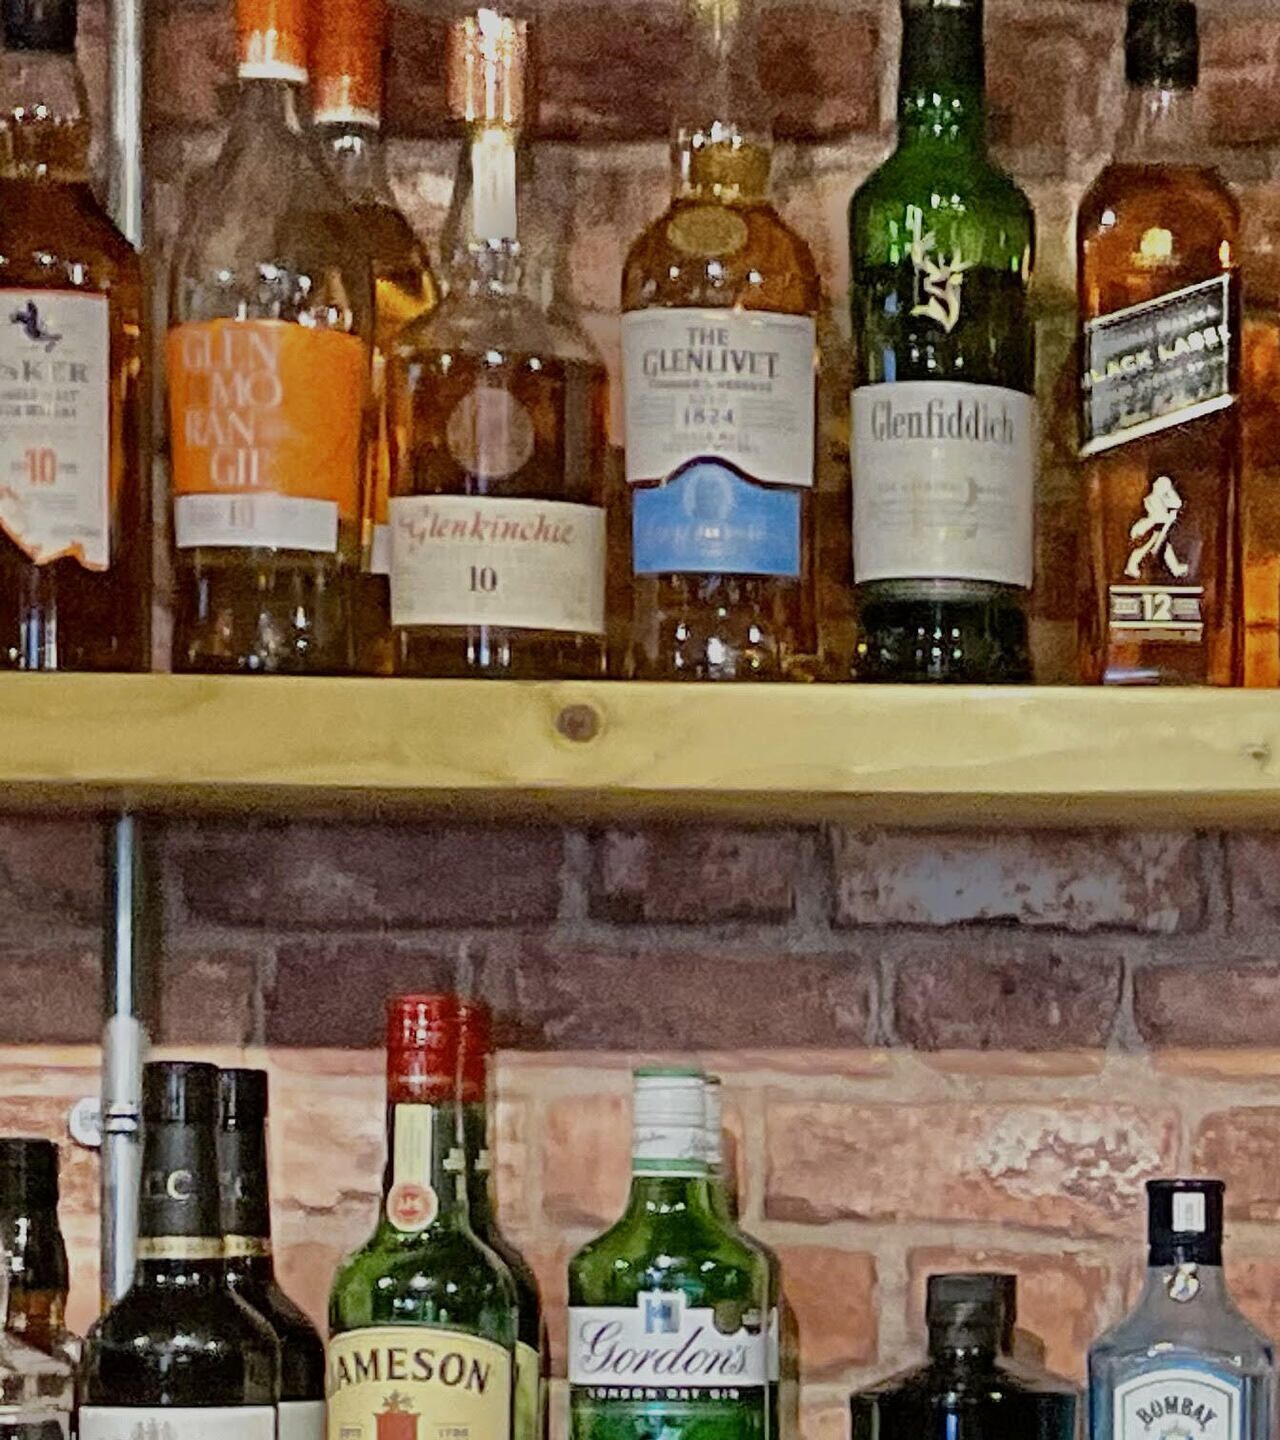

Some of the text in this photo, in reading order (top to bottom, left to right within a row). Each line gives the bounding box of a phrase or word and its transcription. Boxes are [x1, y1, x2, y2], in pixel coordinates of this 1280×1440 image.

[686, 327, 729, 347] THE
[642, 349, 780, 379] GLENLIVET
[869, 400, 1015, 445] Glenfiddich
[25, 447, 57, 486] 10
[467, 564, 498, 593] 10
[1141, 592, 1173, 622] 12
[578, 1318, 751, 1375] Gordon's
[334, 1346, 492, 1396] AMESON
[1135, 1395, 1218, 1432] BOMBAY
